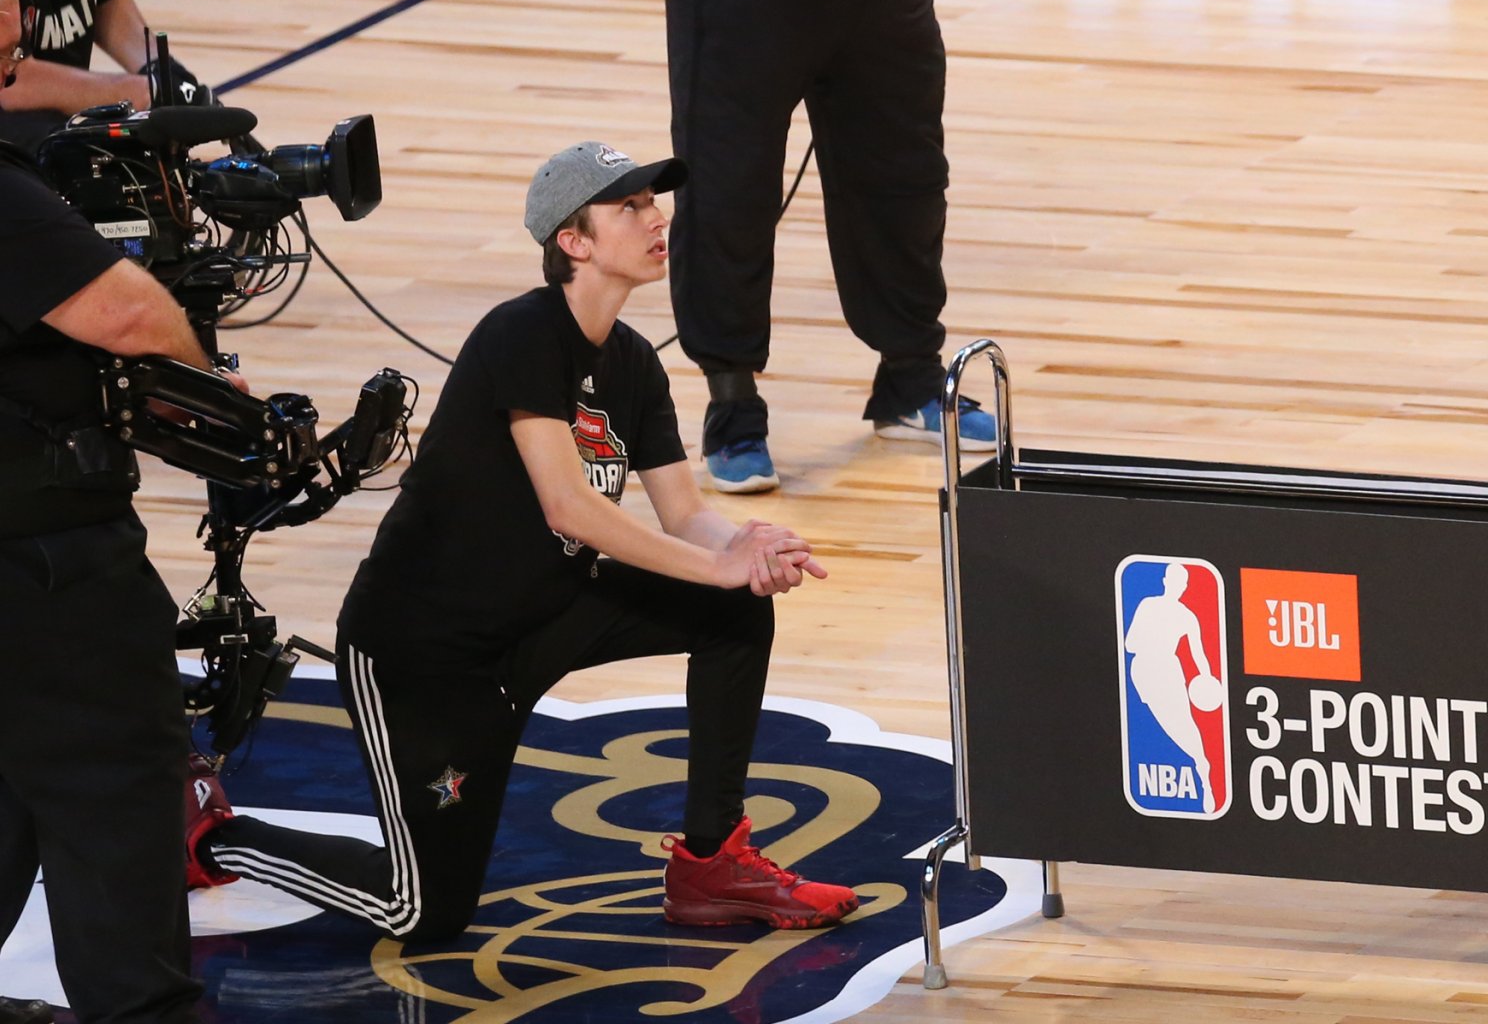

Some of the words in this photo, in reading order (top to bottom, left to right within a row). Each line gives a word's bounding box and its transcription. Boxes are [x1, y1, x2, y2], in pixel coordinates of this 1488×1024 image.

[1267, 601, 1340, 650] JBL
[1245, 686, 1488, 764] 3-POINT
[1137, 762, 1199, 800] NBA
